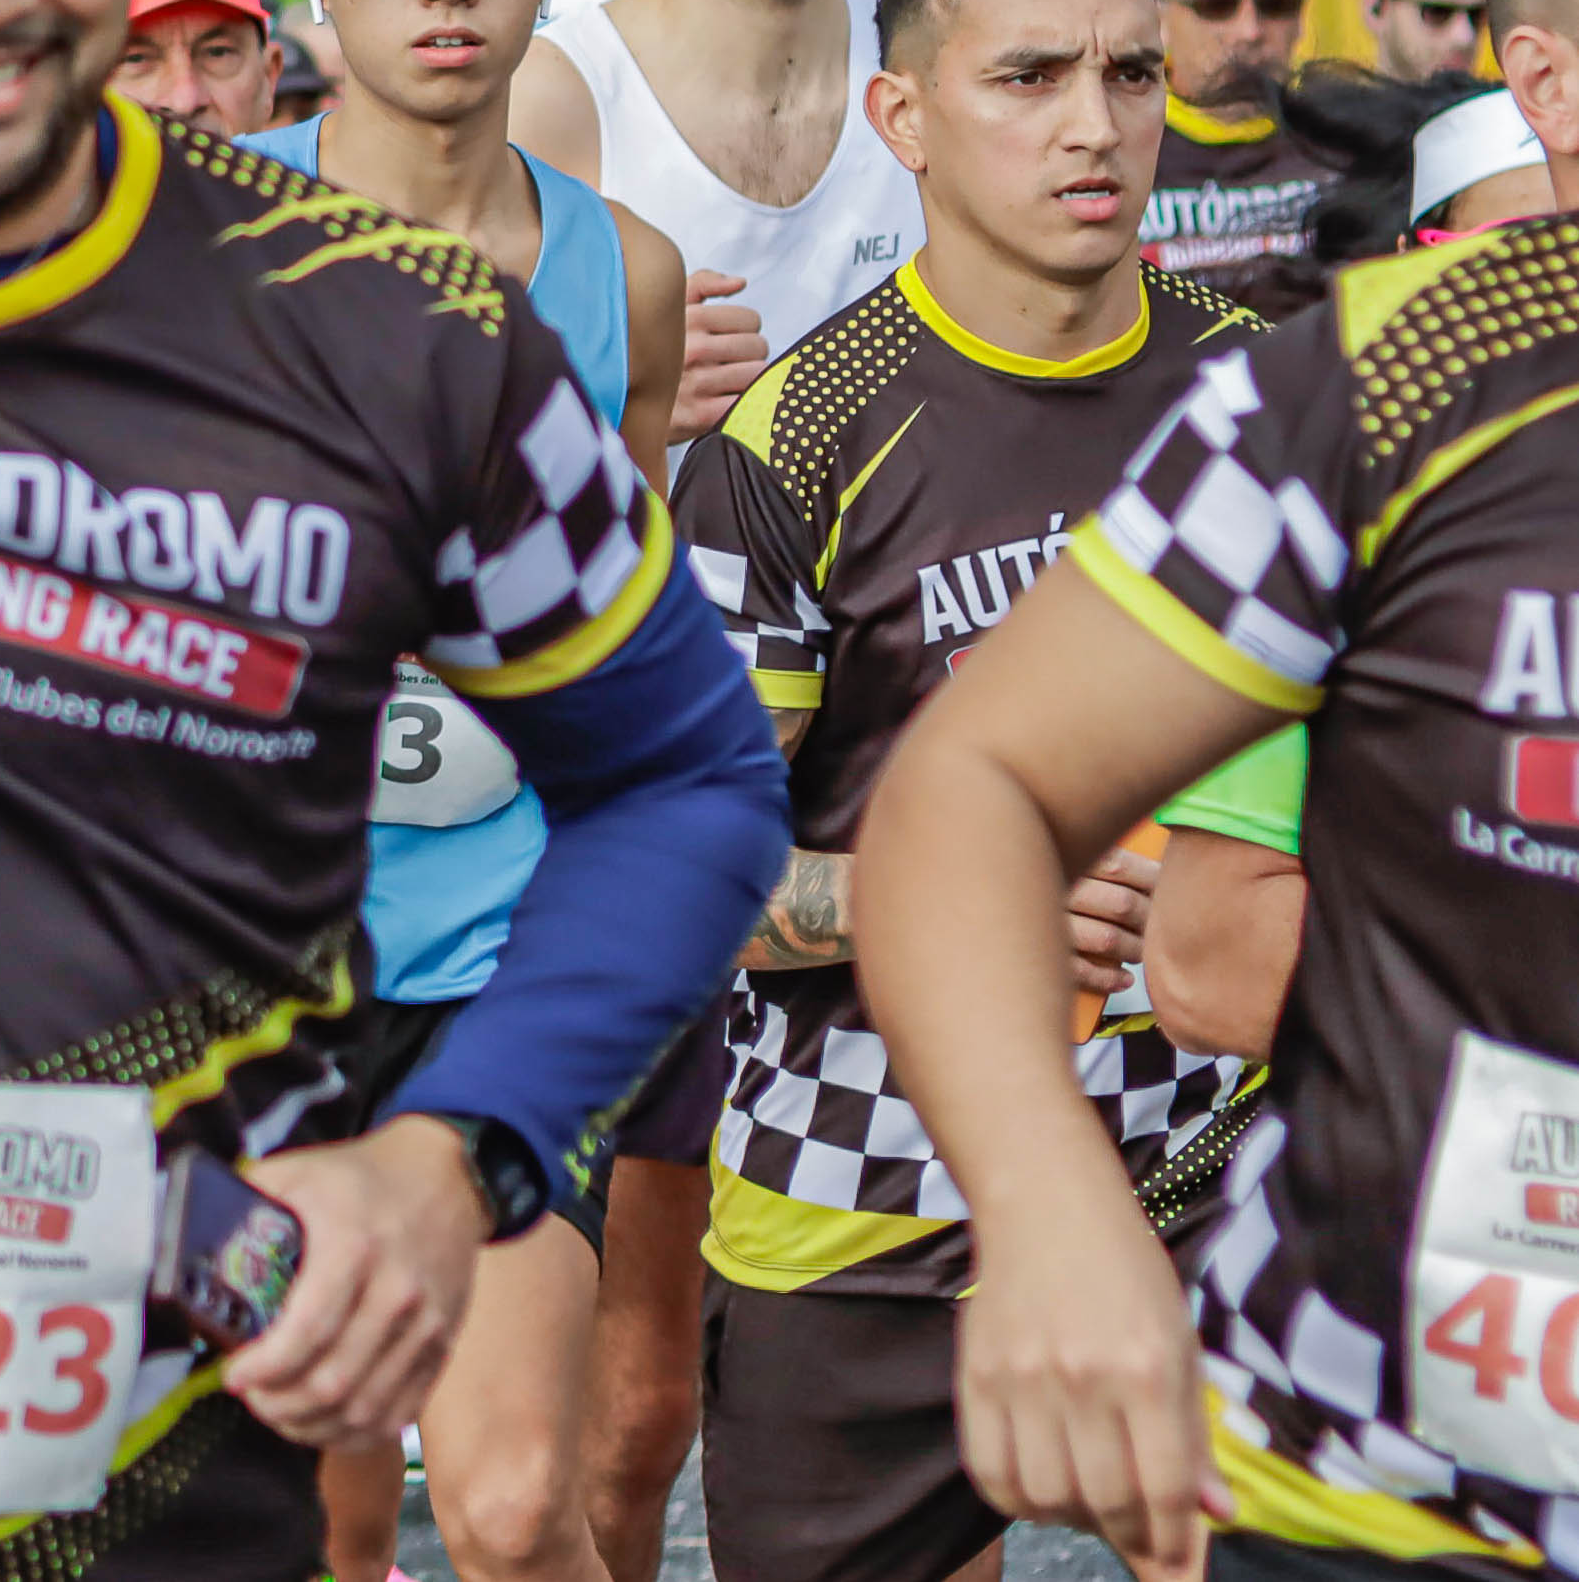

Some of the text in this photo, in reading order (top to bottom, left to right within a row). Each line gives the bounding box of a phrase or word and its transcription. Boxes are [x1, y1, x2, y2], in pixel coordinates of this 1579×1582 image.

[79, 589, 249, 700] RACE
[105, 699, 172, 741] del
[1455, 808, 1496, 854] La
